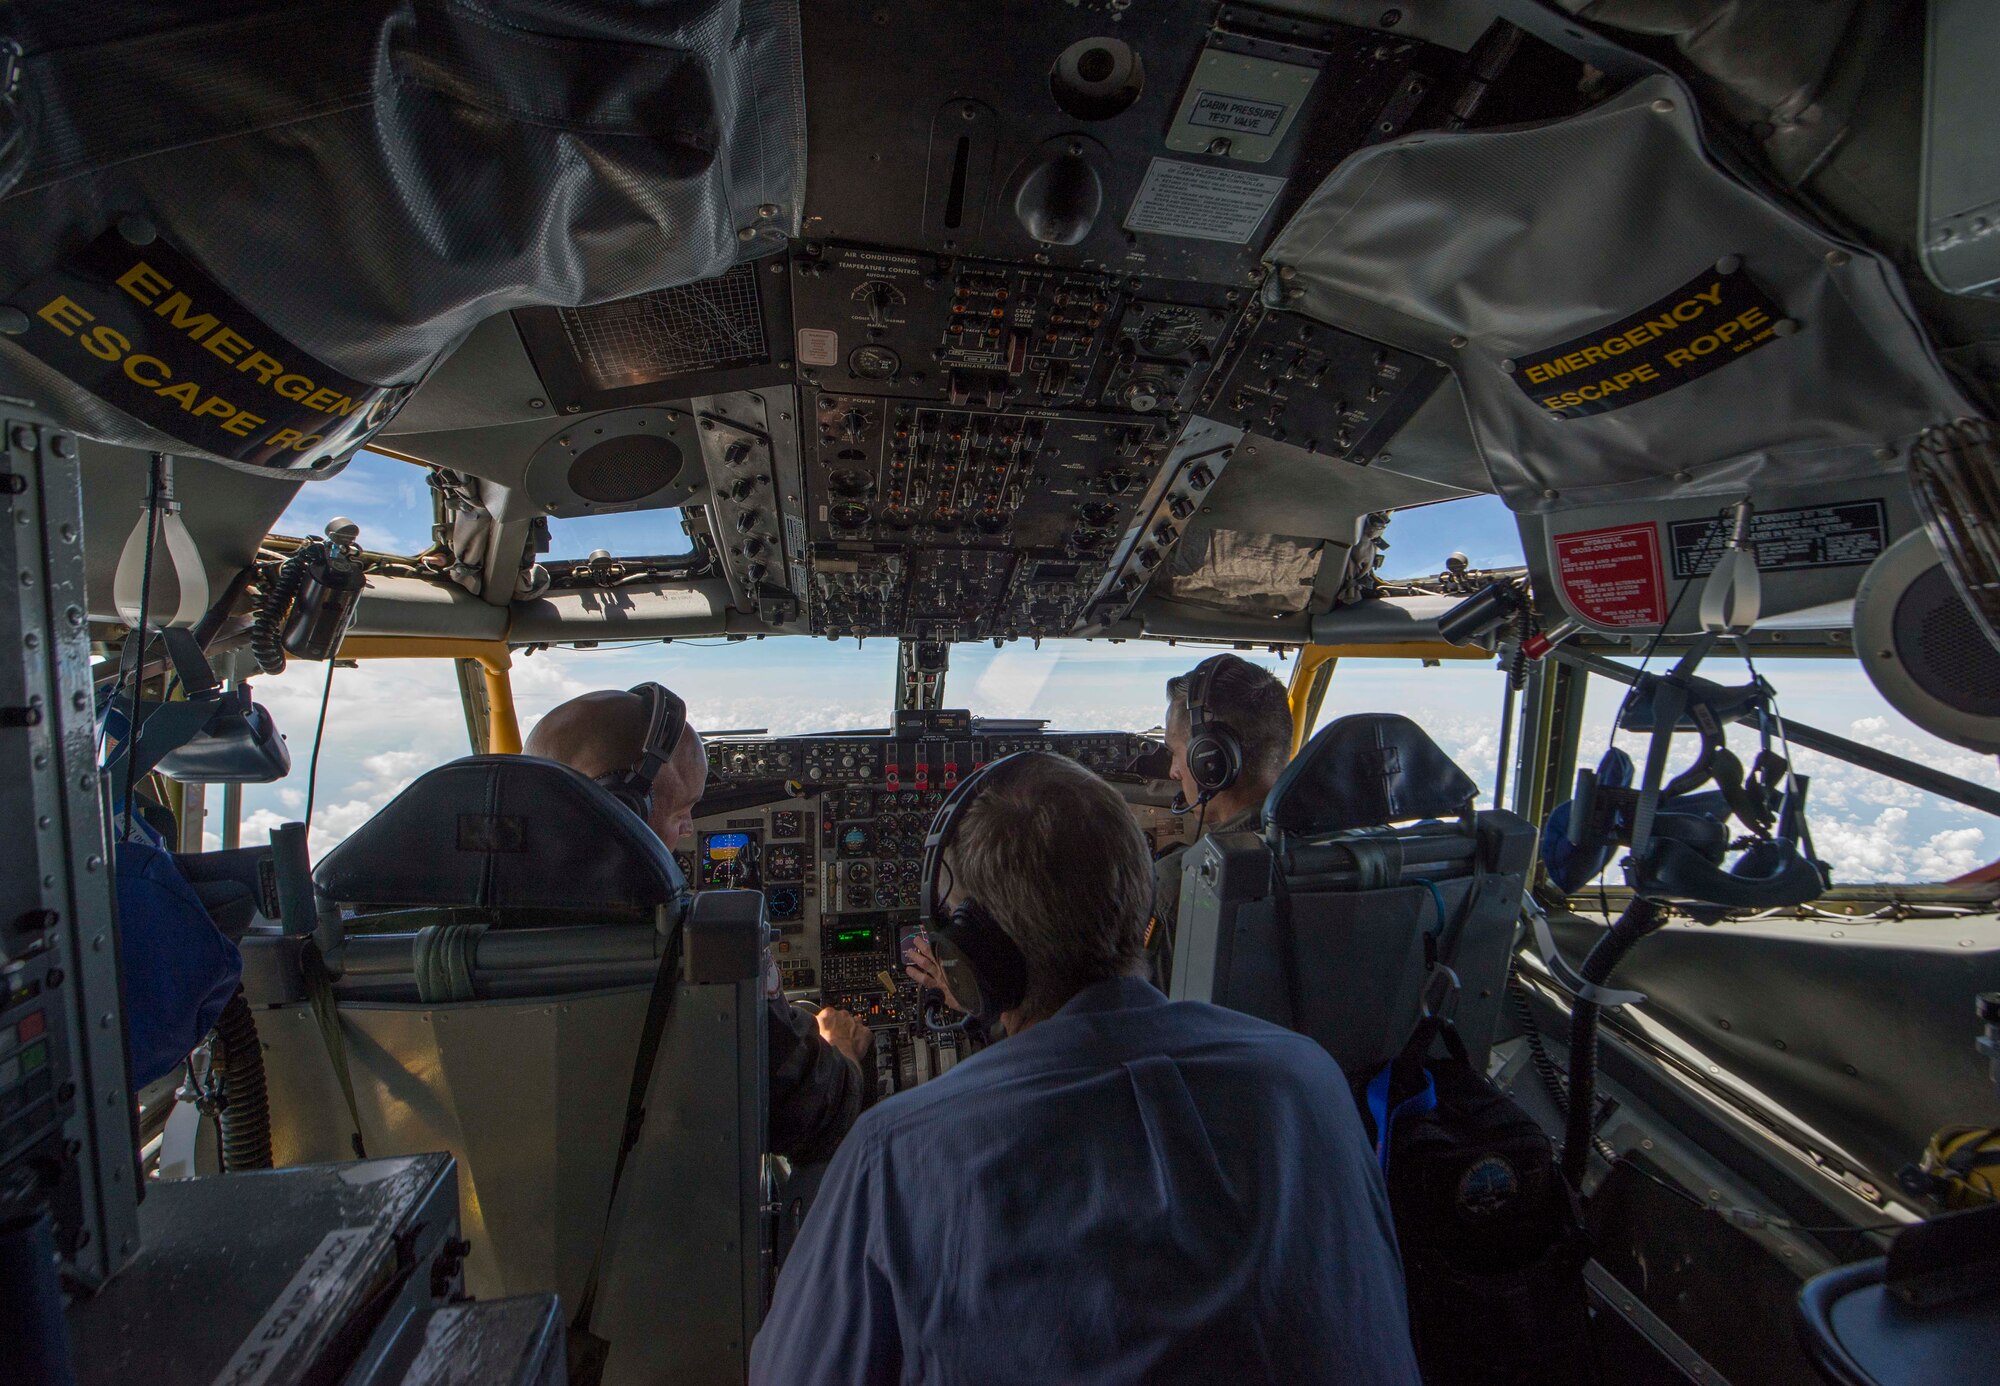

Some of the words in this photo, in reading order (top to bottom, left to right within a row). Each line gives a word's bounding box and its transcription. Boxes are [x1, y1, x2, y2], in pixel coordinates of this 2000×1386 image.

[1199, 98, 1228, 111] CABIN
[1230, 104, 1279, 120] PRESSURE
[1208, 112, 1232, 124] TEST
[1234, 116, 1260, 128] VALVE
[860, 253, 917, 264] CONDITIONING
[838, 262, 886, 272] TEMPERATURE
[888, 267, 921, 276] CONTROL
[866, 272, 897, 280] AUTOMATIC
[115, 260, 365, 417] EMERGEN
[1524, 282, 1722, 385] EMERGENCY
[1543, 363, 1661, 411] ESCAPE
[1663, 306, 1770, 369] ROPE
[36, 294, 267, 437] ESCAPE
[265, 426, 325, 452] RO
[1756, 519, 1801, 531] HYDRAULIC
[1570, 544, 1613, 555] CROSS-OVER
[1614, 540, 1638, 549] VALVE
[1583, 536, 1623, 547] HYDRAULIC
